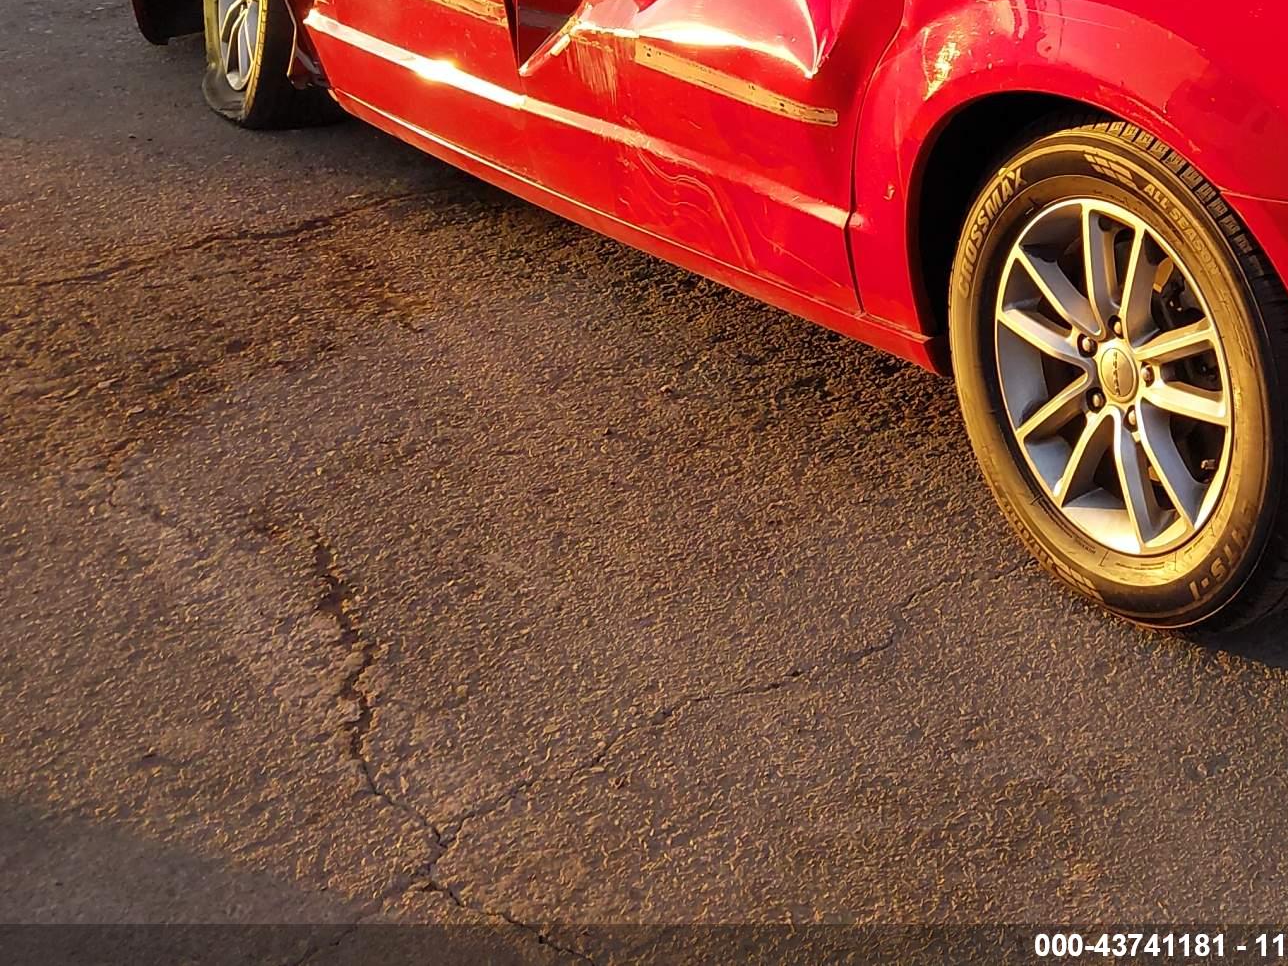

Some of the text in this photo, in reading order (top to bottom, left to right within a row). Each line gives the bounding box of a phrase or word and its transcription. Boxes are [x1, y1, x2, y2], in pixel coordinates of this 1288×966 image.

[958, 166, 1028, 299] CROSSMAX
[1143, 183, 1222, 276] ALL SEASON
